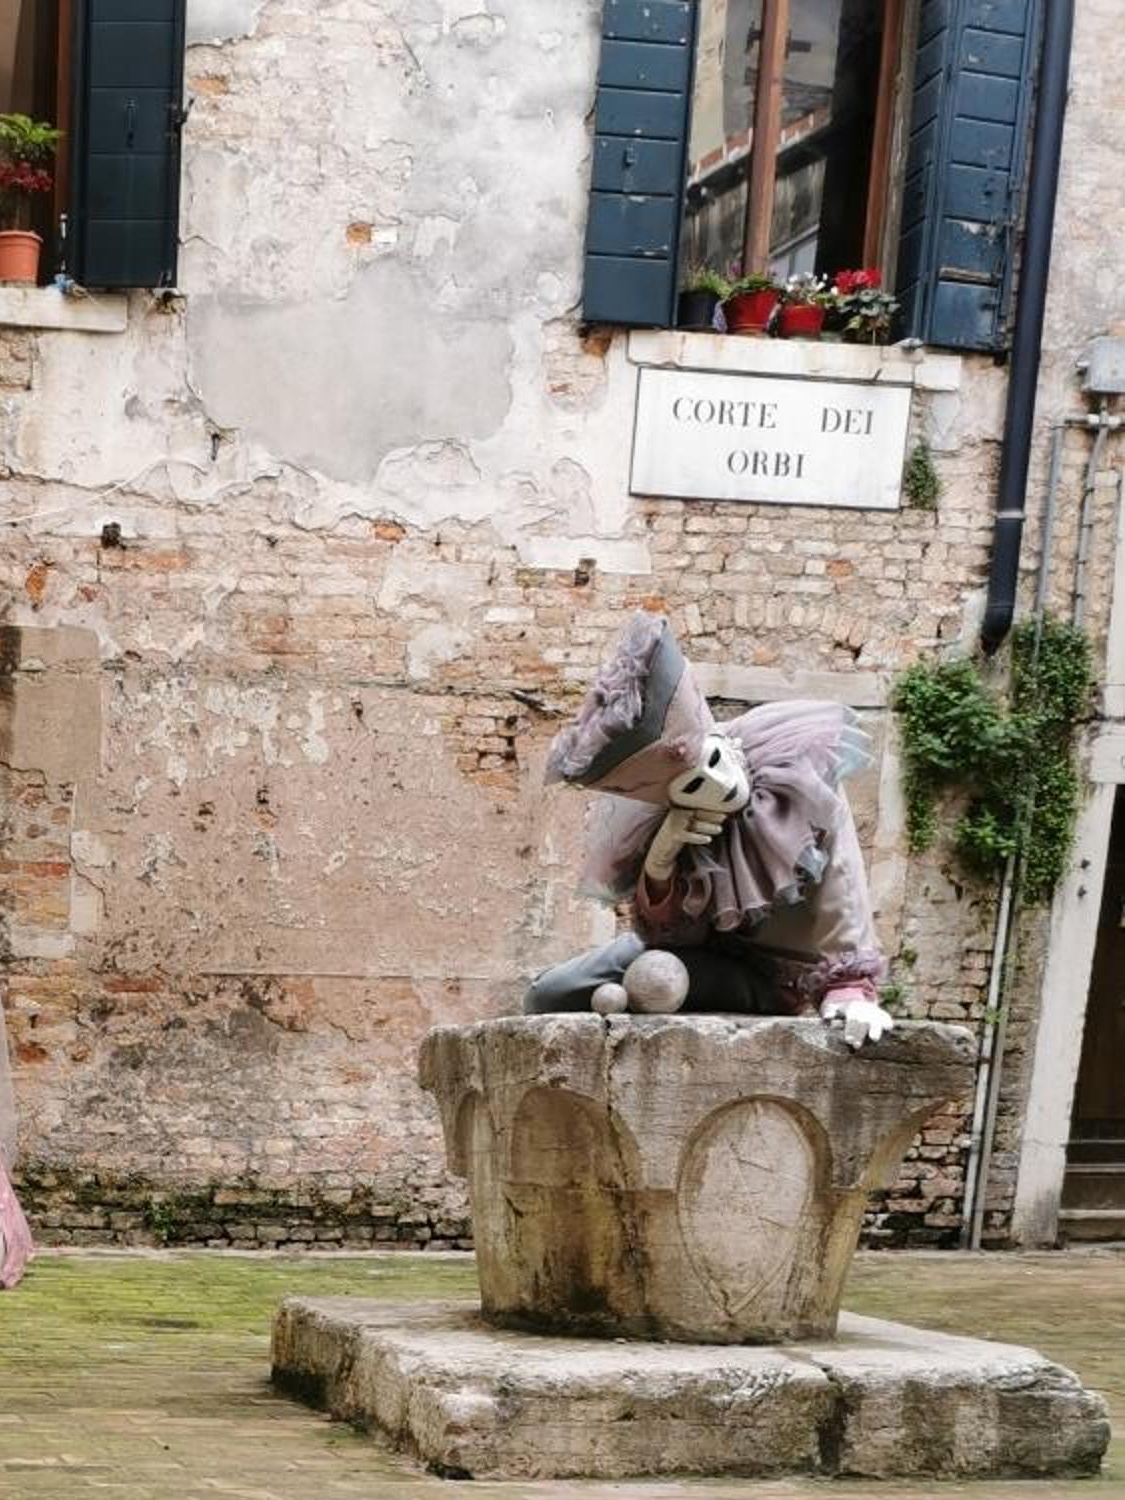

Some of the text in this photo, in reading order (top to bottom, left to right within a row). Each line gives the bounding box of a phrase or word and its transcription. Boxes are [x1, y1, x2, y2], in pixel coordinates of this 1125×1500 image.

[672, 397, 874, 435] CORTE DEI
[727, 450, 805, 478] ORBI
